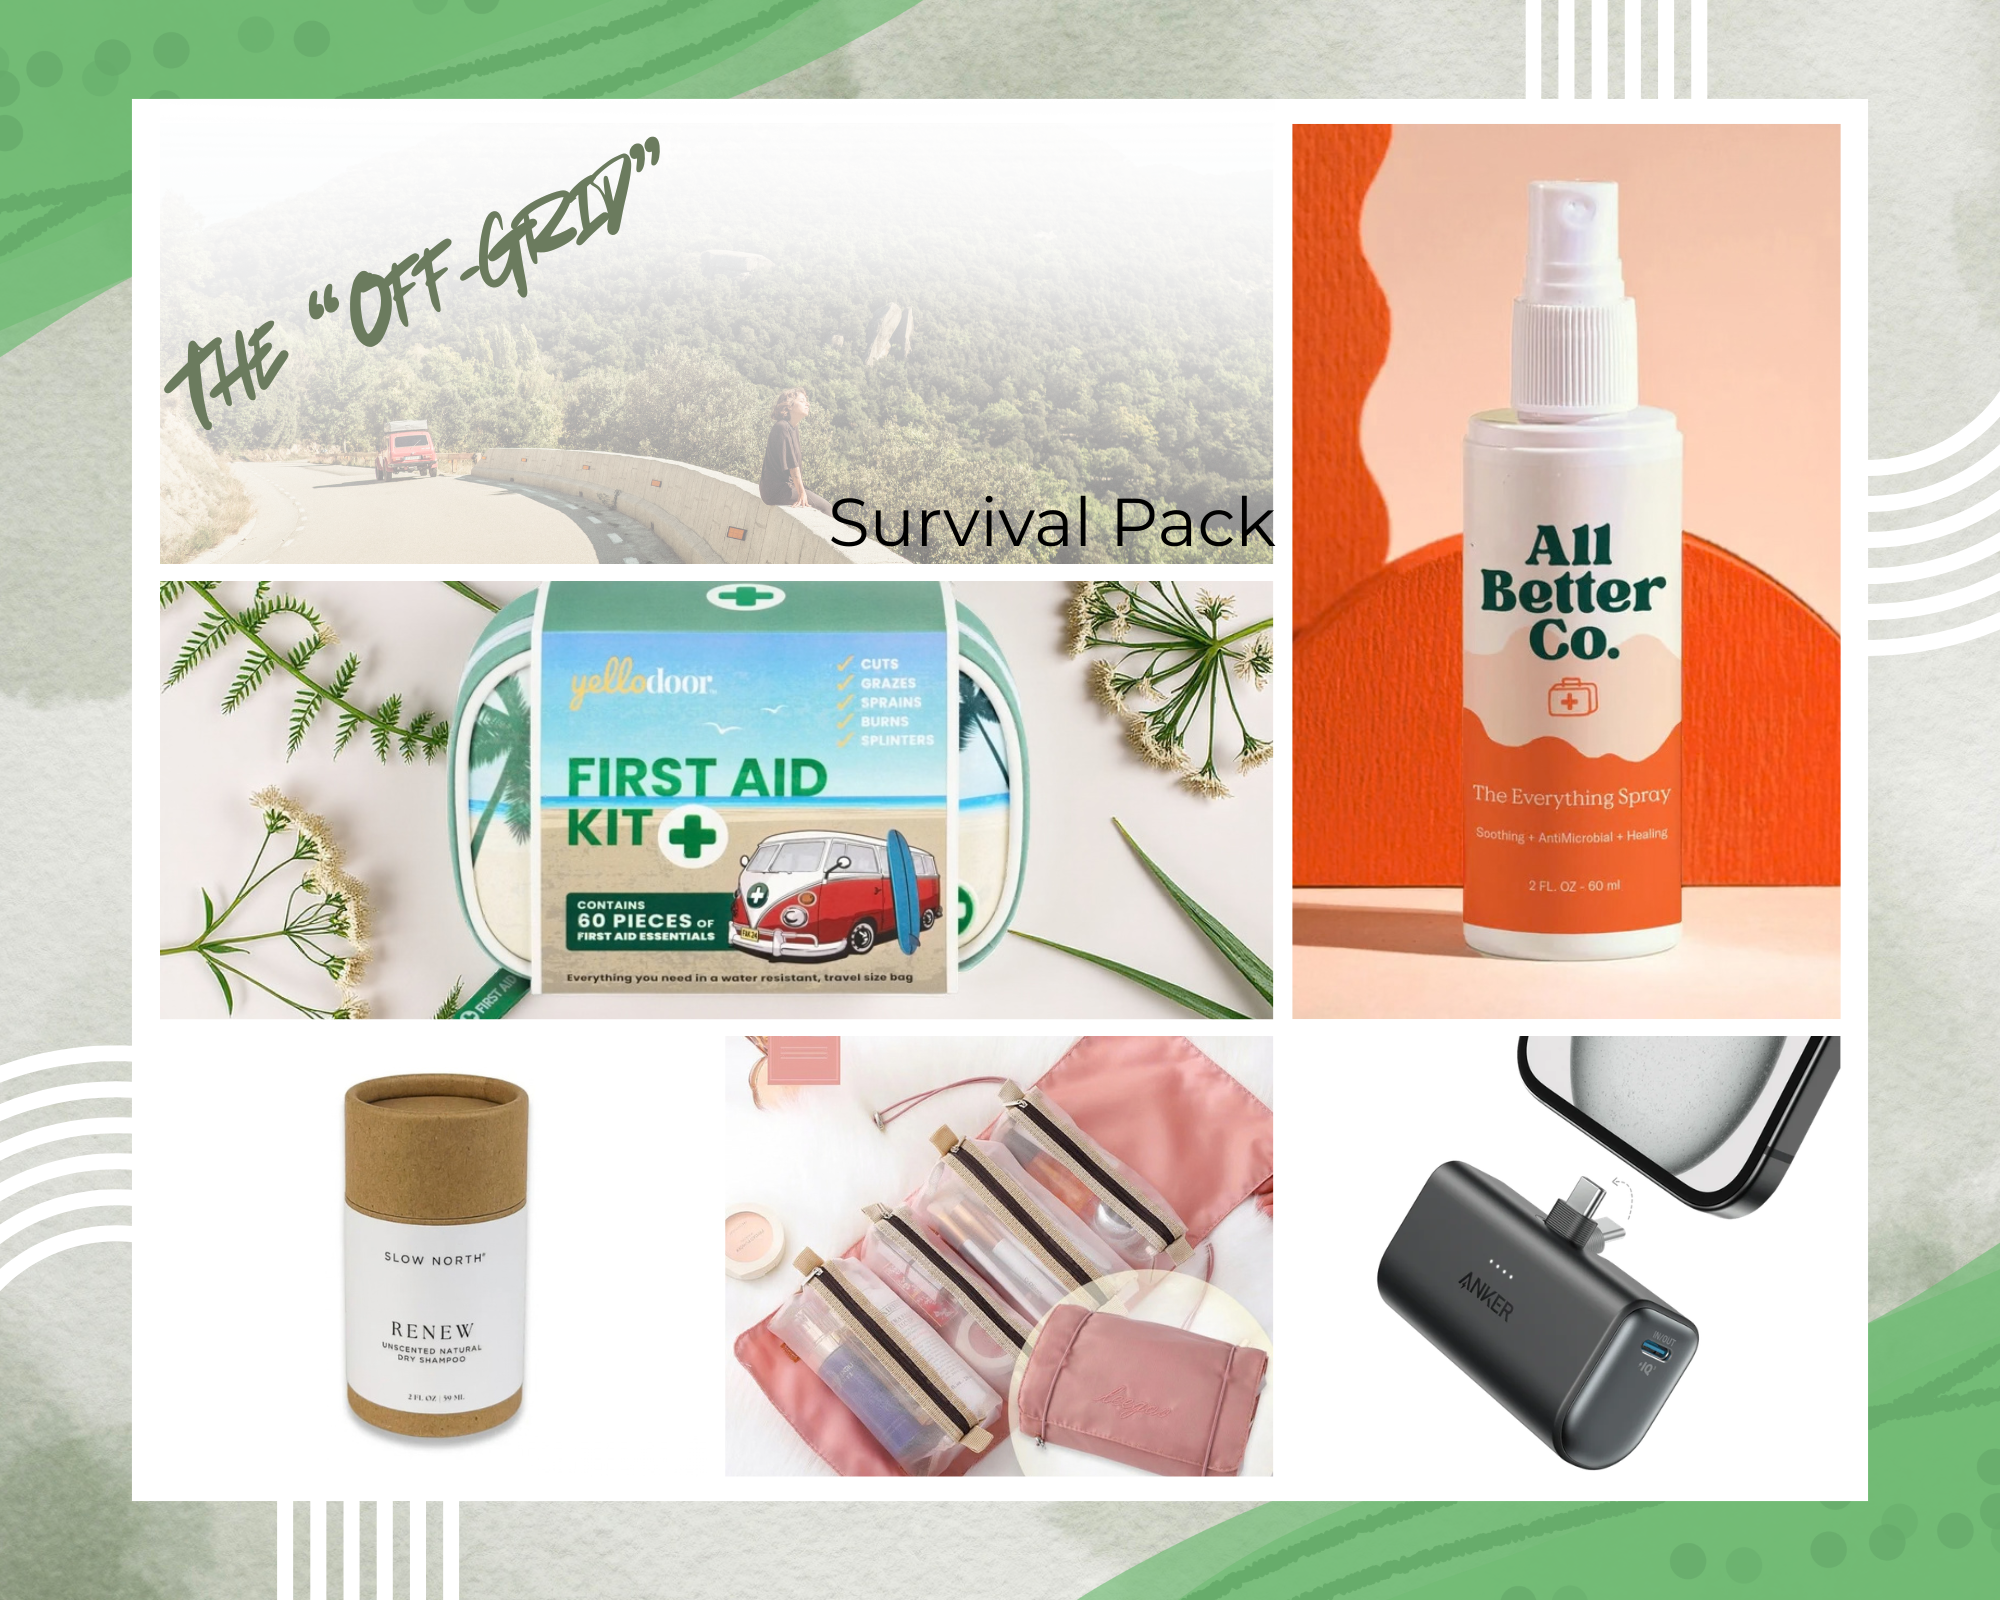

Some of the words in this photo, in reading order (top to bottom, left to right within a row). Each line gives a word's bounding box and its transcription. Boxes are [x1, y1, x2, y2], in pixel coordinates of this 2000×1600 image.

[1525, 522, 1613, 566] All
[1480, 568, 1667, 614] Better
[1529, 618, 1620, 660] Co.
[860, 658, 899, 670] CUTS
[860, 677, 916, 690] GRAZES
[860, 696, 922, 709] SPRAINS
[861, 715, 909, 728] BURNS
[860, 734, 935, 747] SPLINTERS
[568, 757, 717, 798] FIRST
[730, 757, 828, 797] AID
[1473, 784, 1507, 804] The
[1512, 788, 1614, 810] Everything
[1618, 787, 1671, 808] Spray
[567, 808, 653, 846] KIT
[1476, 826, 1525, 844] Soothing
[1538, 831, 1613, 844] AntiMicrobial
[1627, 828, 1668, 840] Healing
[1529, 880, 1536, 891] 2
[1539, 880, 1557, 891] FL.
[1560, 881, 1576, 892] OZ
[1588, 880, 1604, 891] 60
[1607, 879, 1620, 890] ml
[577, 901, 645, 910] CONTAINS
[577, 913, 605, 928] 60
[613, 913, 692, 928] PIECES
[697, 919, 714, 928] OF
[577, 932, 611, 941] FIRST
[614, 932, 637, 941] AID
[639, 932, 715, 941] ESSENTIALS
[567, 973, 632, 984] Everything
[636, 975, 658, 984] you
[661, 973, 692, 982] need
[696, 973, 707, 982] in
[721, 974, 757, 982] water
[761, 973, 821, 983] resistant,
[824, 973, 861, 982] travel
[864, 973, 887, 982] size
[890, 973, 913, 983] bag
[475, 988, 502, 1014] FIRST
[499, 975, 517, 992] AID
[384, 1251, 424, 1265] SLOW
[1458, 1271, 1514, 1323] ANKER
[391, 1321, 474, 1340] RENEW
[1653, 1330, 1676, 1346] IN/OUT
[382, 1341, 436, 1355] UNSCENTED
[439, 1344, 482, 1355] NATURAL
[397, 1354, 415, 1362] DRY
[419, 1355, 466, 1363] SHAMPOO
